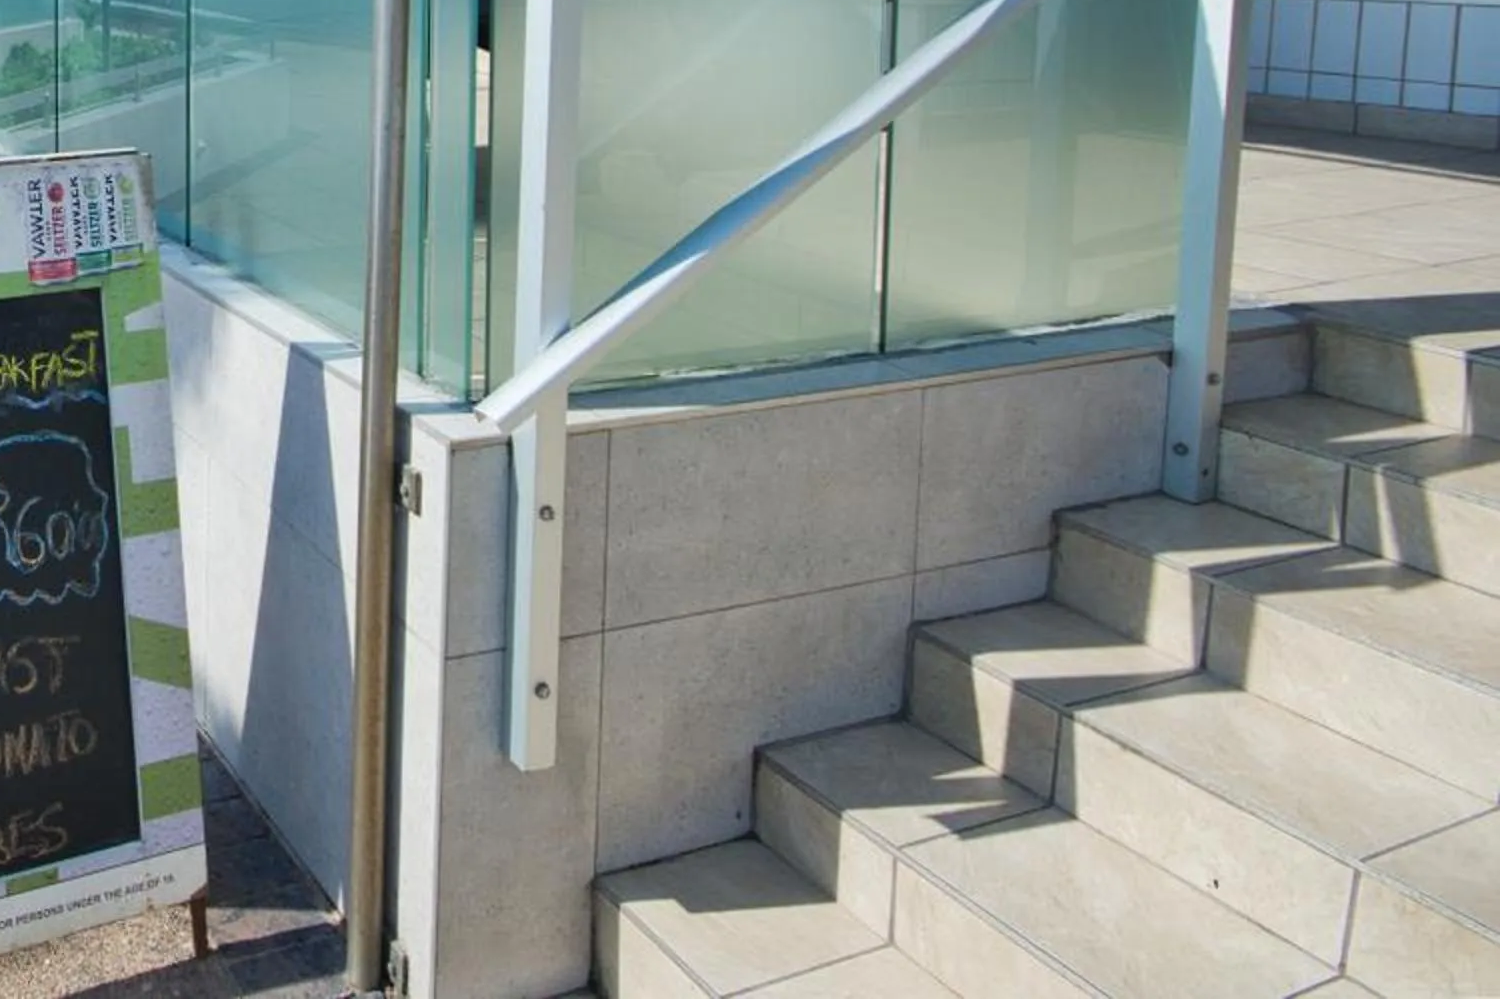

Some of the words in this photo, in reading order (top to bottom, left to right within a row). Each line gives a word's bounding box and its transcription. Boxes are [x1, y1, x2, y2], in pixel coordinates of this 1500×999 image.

[15, 904, 64, 925] PERSONS
[66, 894, 100, 912] UNDER
[103, 887, 123, 901] THE
